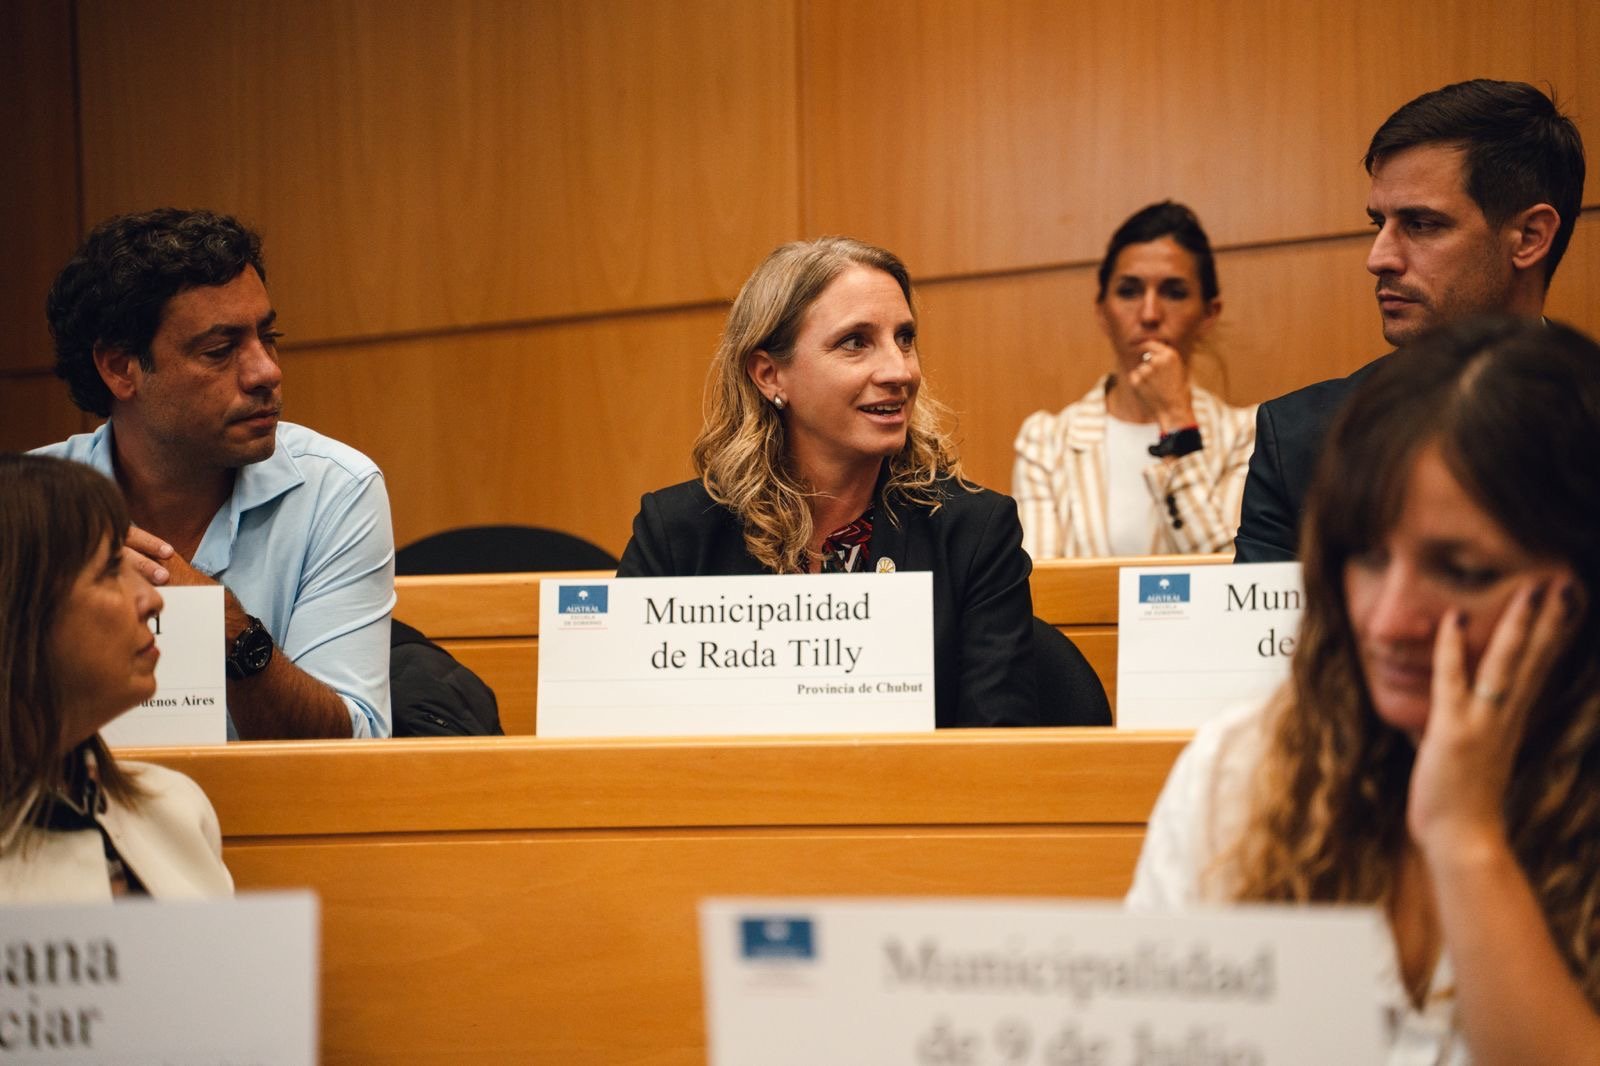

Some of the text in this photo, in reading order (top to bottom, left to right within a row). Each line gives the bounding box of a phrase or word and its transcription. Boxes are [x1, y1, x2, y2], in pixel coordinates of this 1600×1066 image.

[565, 605, 600, 614] AUSTRAL
[644, 592, 871, 630] Municipalidad
[1257, 628, 1295, 658] de
[650, 637, 864, 674] de Rada Tilly
[797, 681, 924, 695] Provincia de Chubut
[138, 694, 216, 708] uenos Aires
